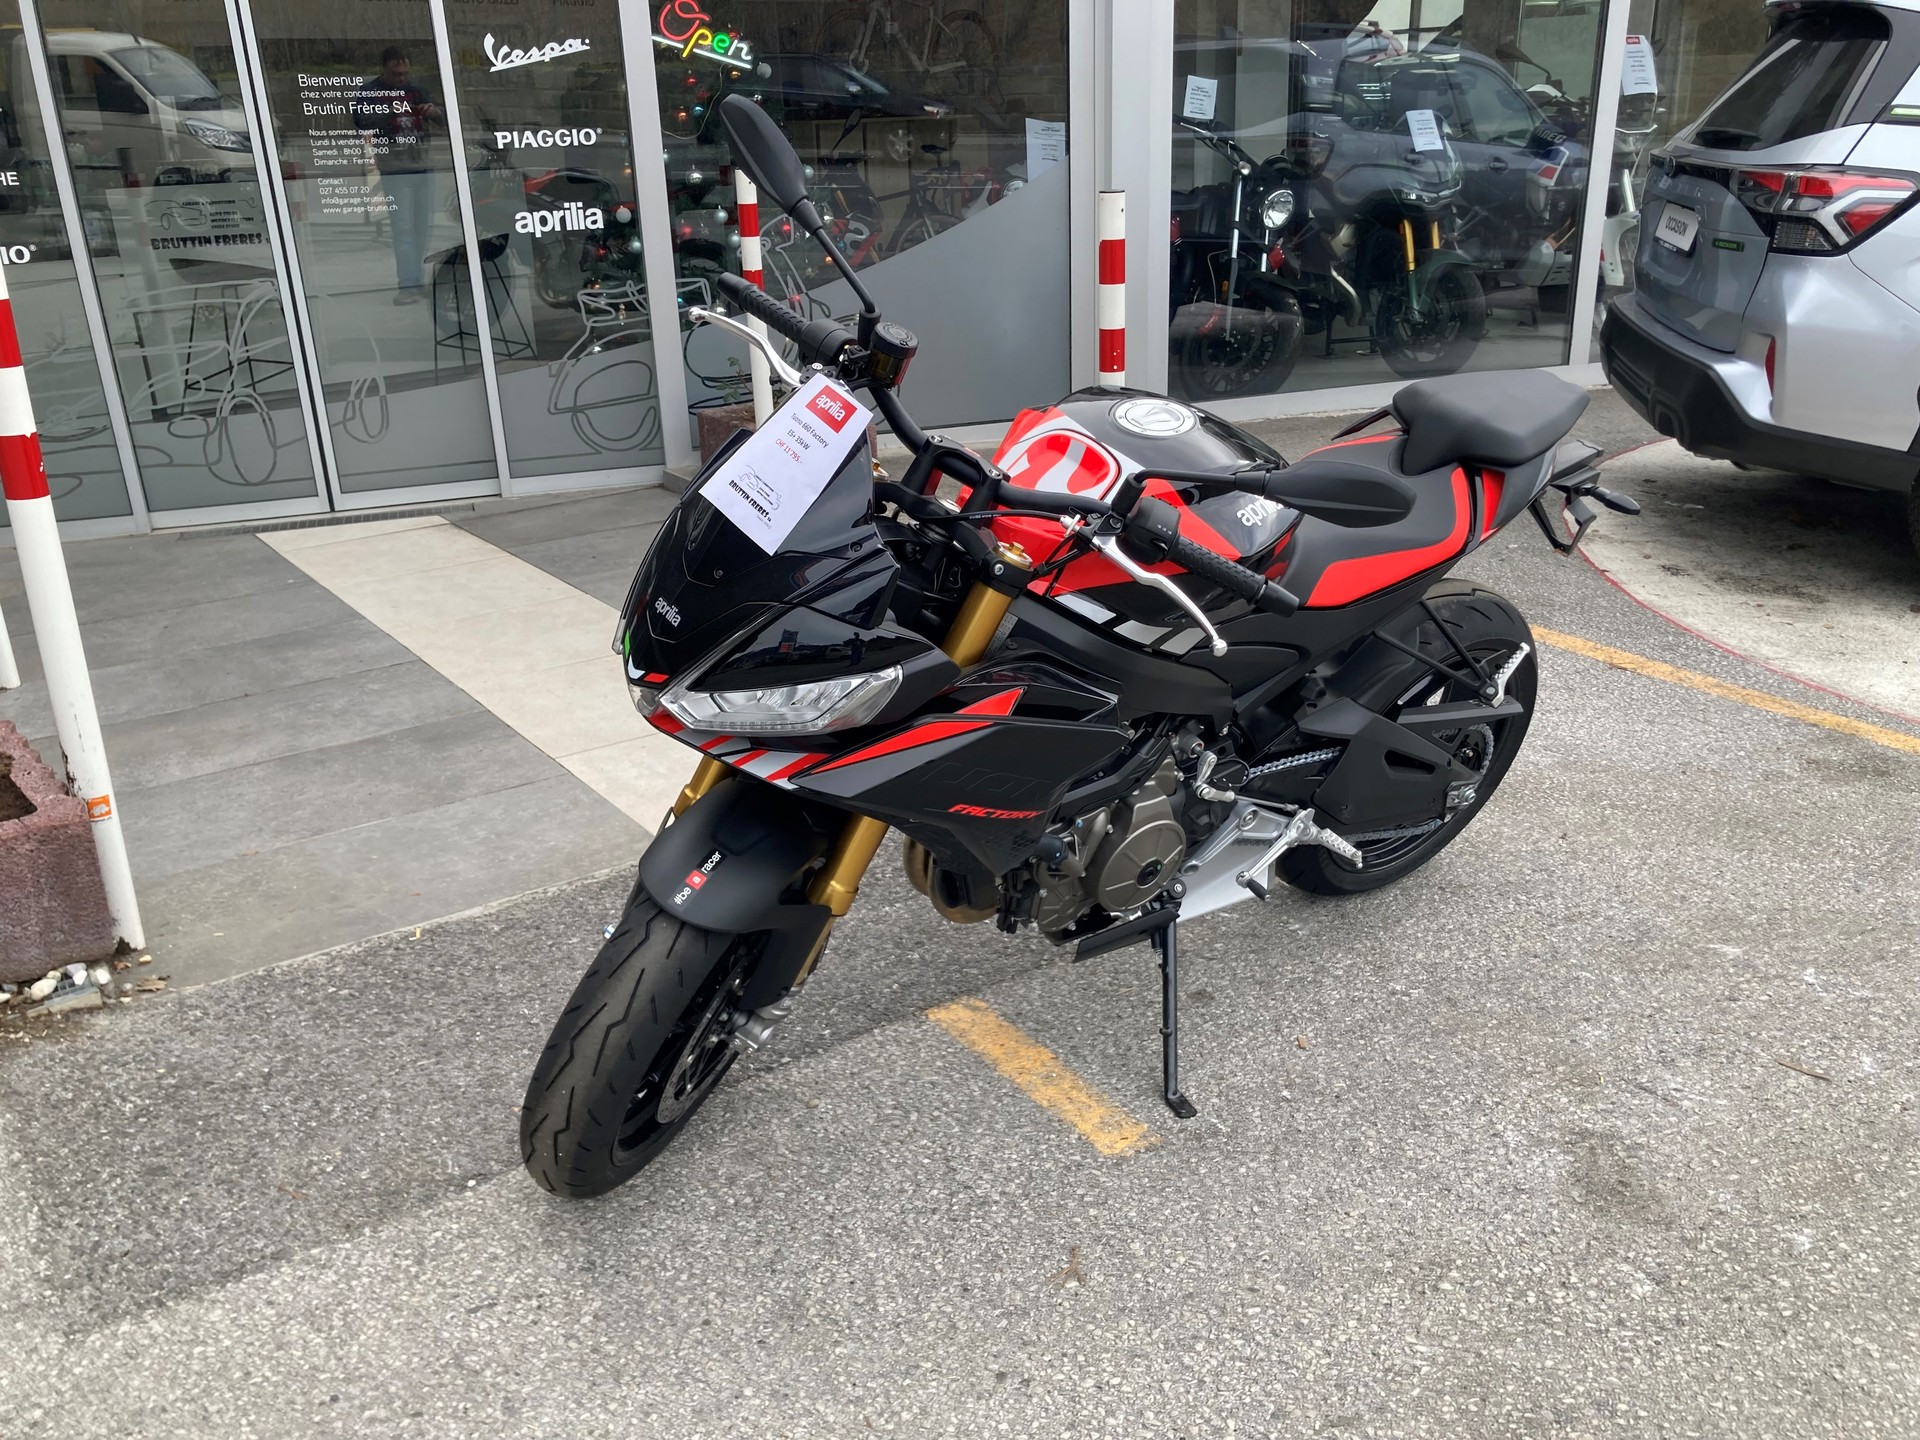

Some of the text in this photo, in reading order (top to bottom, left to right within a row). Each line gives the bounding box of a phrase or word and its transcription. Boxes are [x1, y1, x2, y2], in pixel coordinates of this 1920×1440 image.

[659, 0, 752, 60] Open
[484, 33, 590, 72] Vespa
[298, 74, 363, 87] Bienvenue
[301, 90, 320, 98] chez
[343, 88, 405, 97] concessionnaire
[303, 101, 412, 115] Bruttin Frères SA
[396, 136, 417, 144] 18h00
[312, 148, 338, 156] Samedi
[343, 147, 361, 155] 8h00
[314, 158, 348, 166] Dimanche
[353, 157, 375, 165] Fermé
[319, 187, 332, 195] 027
[349, 186, 358, 194] 07
[515, 202, 604, 238] aprilia
[1665, 216, 1689, 236] OCCASION
[150, 235, 212, 250] BRUTTIN
[214, 232, 262, 247] FRERES
[816, 395, 846, 422] aprilia
[775, 438, 786, 449] CHF
[801, 423, 813, 432] 660
[810, 429, 829, 448] Factory
[728, 480, 751, 501] BRUTTIN
[748, 498, 770, 518] FRERES
[655, 597, 681, 627] aprilia
[948, 803, 1040, 819] FACTORY
[673, 887, 692, 905] #be
[701, 851, 721, 874] racer
